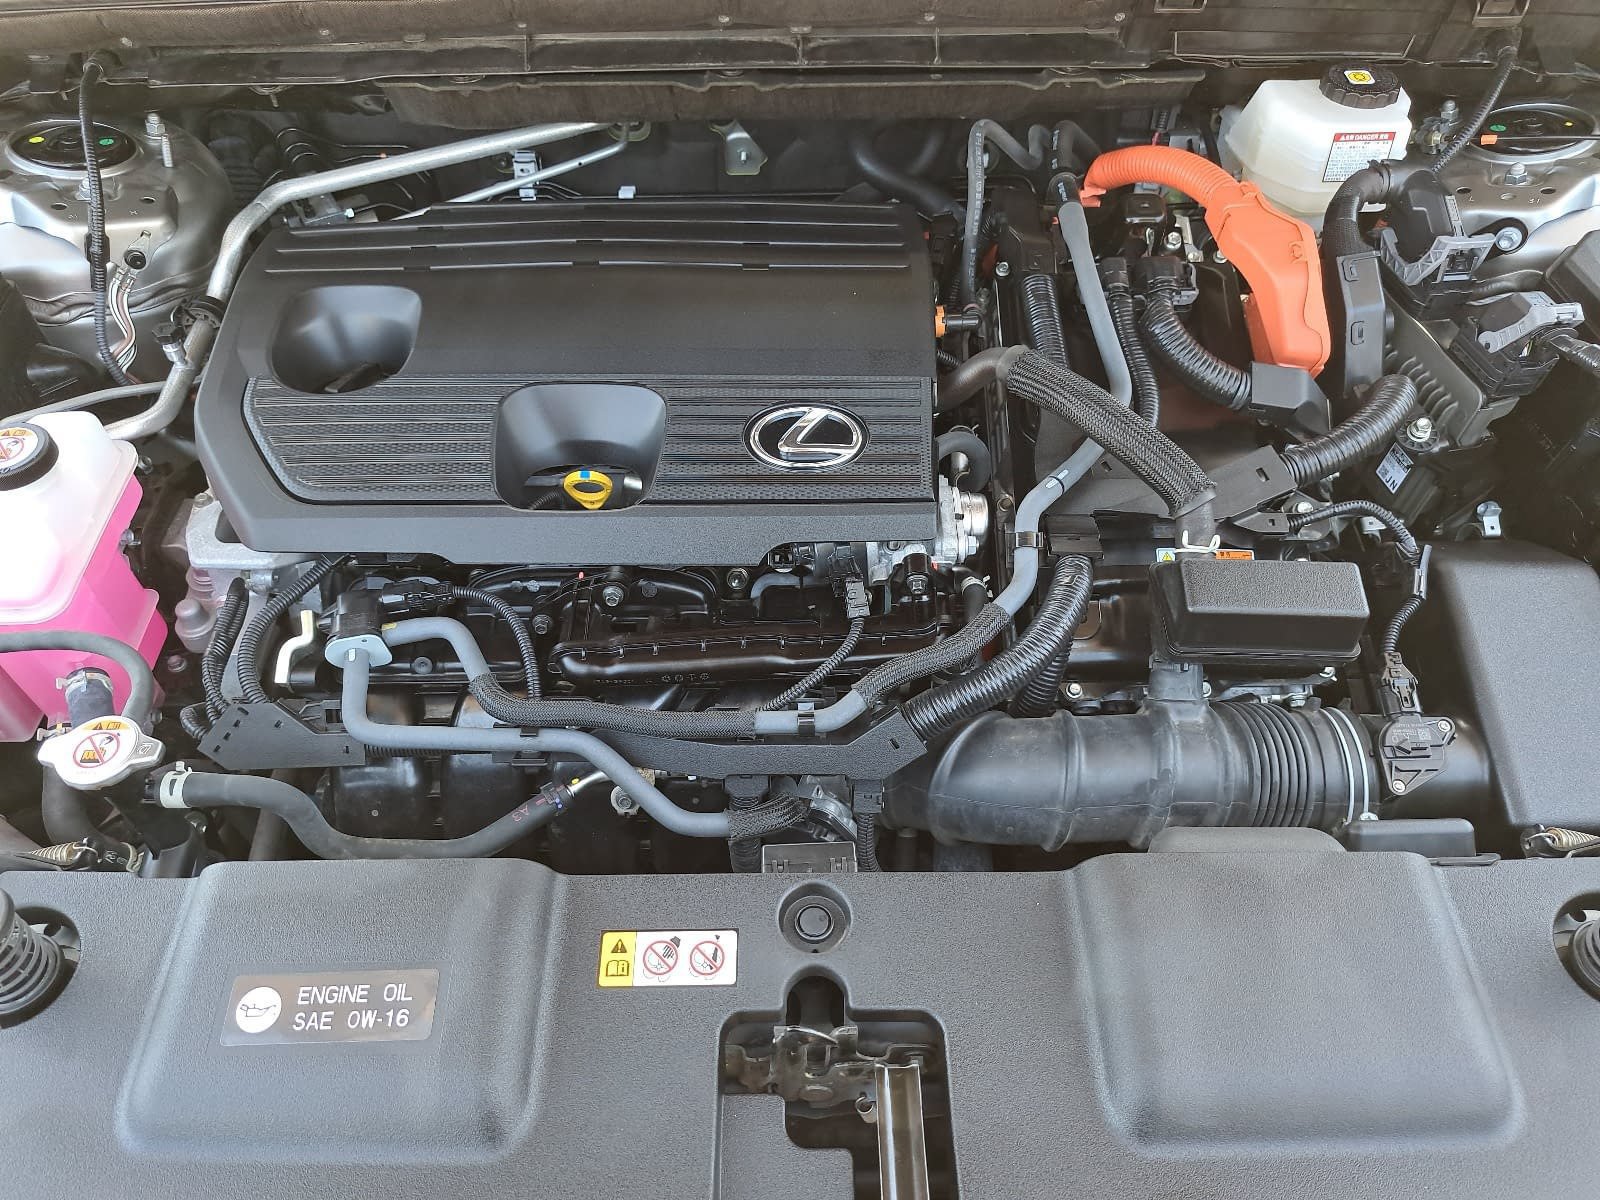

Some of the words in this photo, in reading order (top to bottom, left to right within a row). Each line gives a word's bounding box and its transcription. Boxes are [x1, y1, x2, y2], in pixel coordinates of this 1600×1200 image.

[297, 984, 371, 1005] ENGINE
[383, 983, 413, 1002] OIL
[292, 1011, 335, 1031] SAE
[347, 1008, 410, 1029] 0W-16
